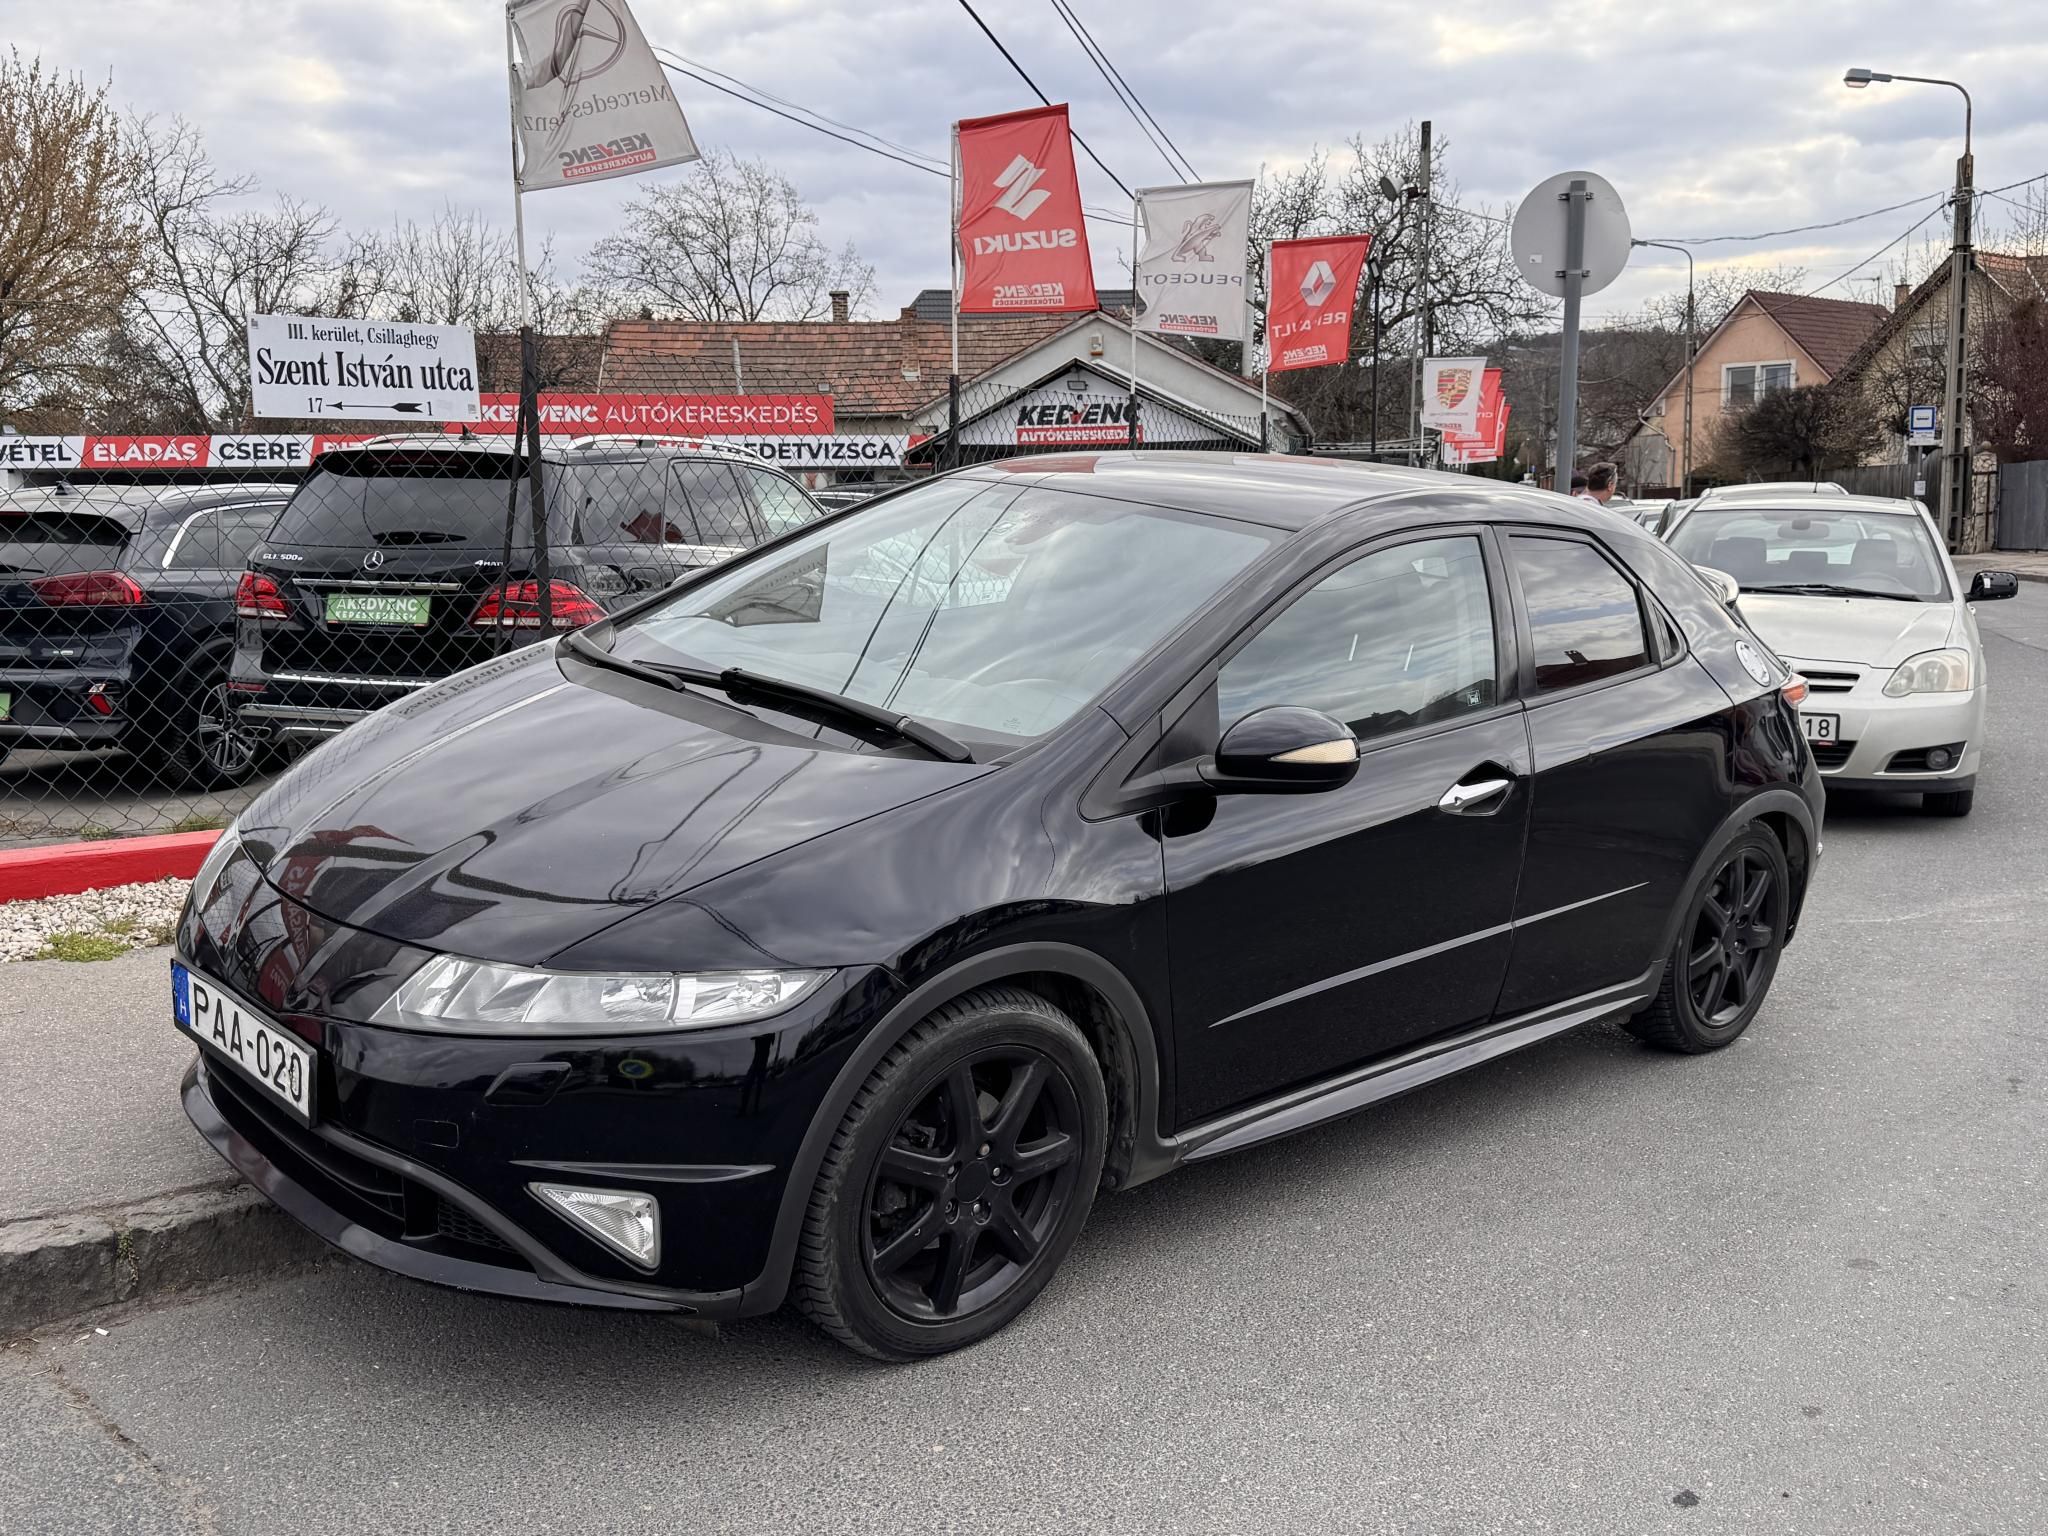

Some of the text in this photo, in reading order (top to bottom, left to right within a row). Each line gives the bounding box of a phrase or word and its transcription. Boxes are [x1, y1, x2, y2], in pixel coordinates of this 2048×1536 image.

[288, 323, 439, 349] III. kerület, Csillaghegy
[257, 348, 474, 392] Szent István utca
[307, 397, 434, 417] 17 1
[482, 402, 818, 423] KEVENC AUTÓKERESKEDÉS
[93, 439, 197, 461] ELADÁS
[219, 443, 301, 460] CSERE
[1806, 718, 1830, 738] 18
[180, 999, 187, 1017] H
[193, 982, 303, 1103] PAA-020
